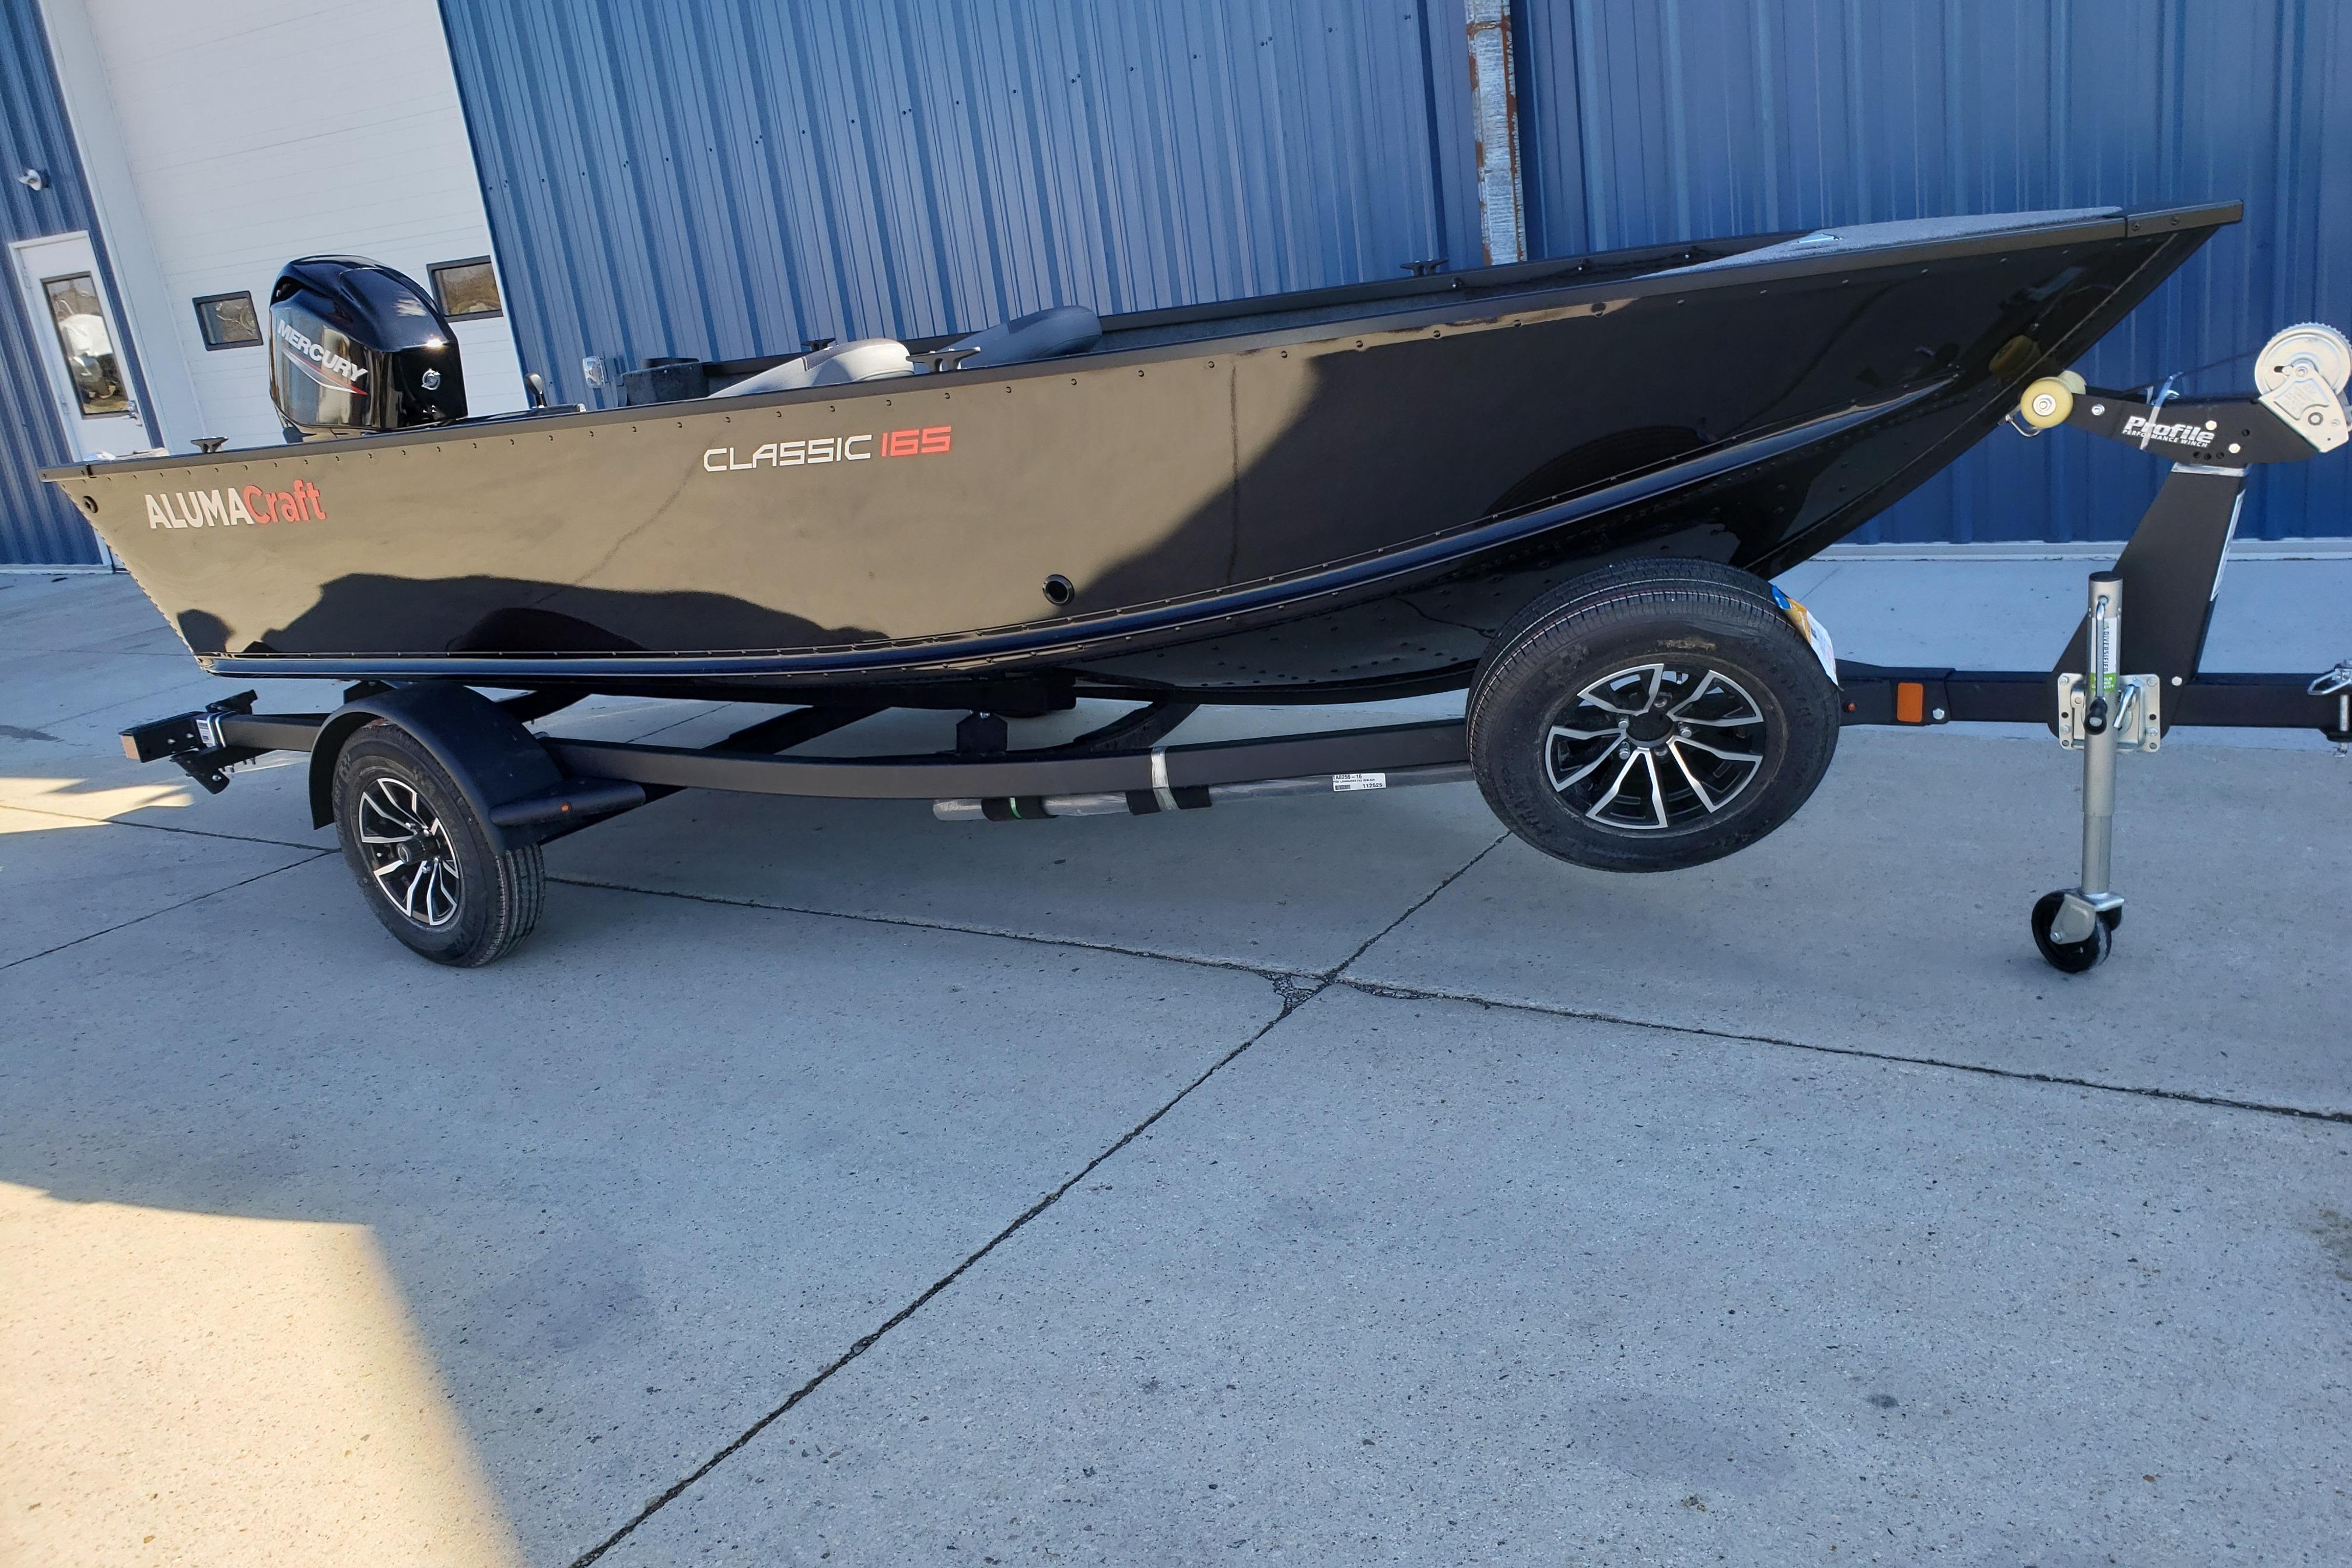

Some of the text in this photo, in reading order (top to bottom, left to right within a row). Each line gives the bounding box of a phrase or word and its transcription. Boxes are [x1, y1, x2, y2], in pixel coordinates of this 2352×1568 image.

[277, 319, 369, 382] MERCURY
[704, 425, 952, 472] CLASSIC 165
[2122, 429, 2208, 448] PERFOMANCE WINCH
[2123, 416, 2215, 444] Profile
[145, 478, 326, 529] ALUMACraft
